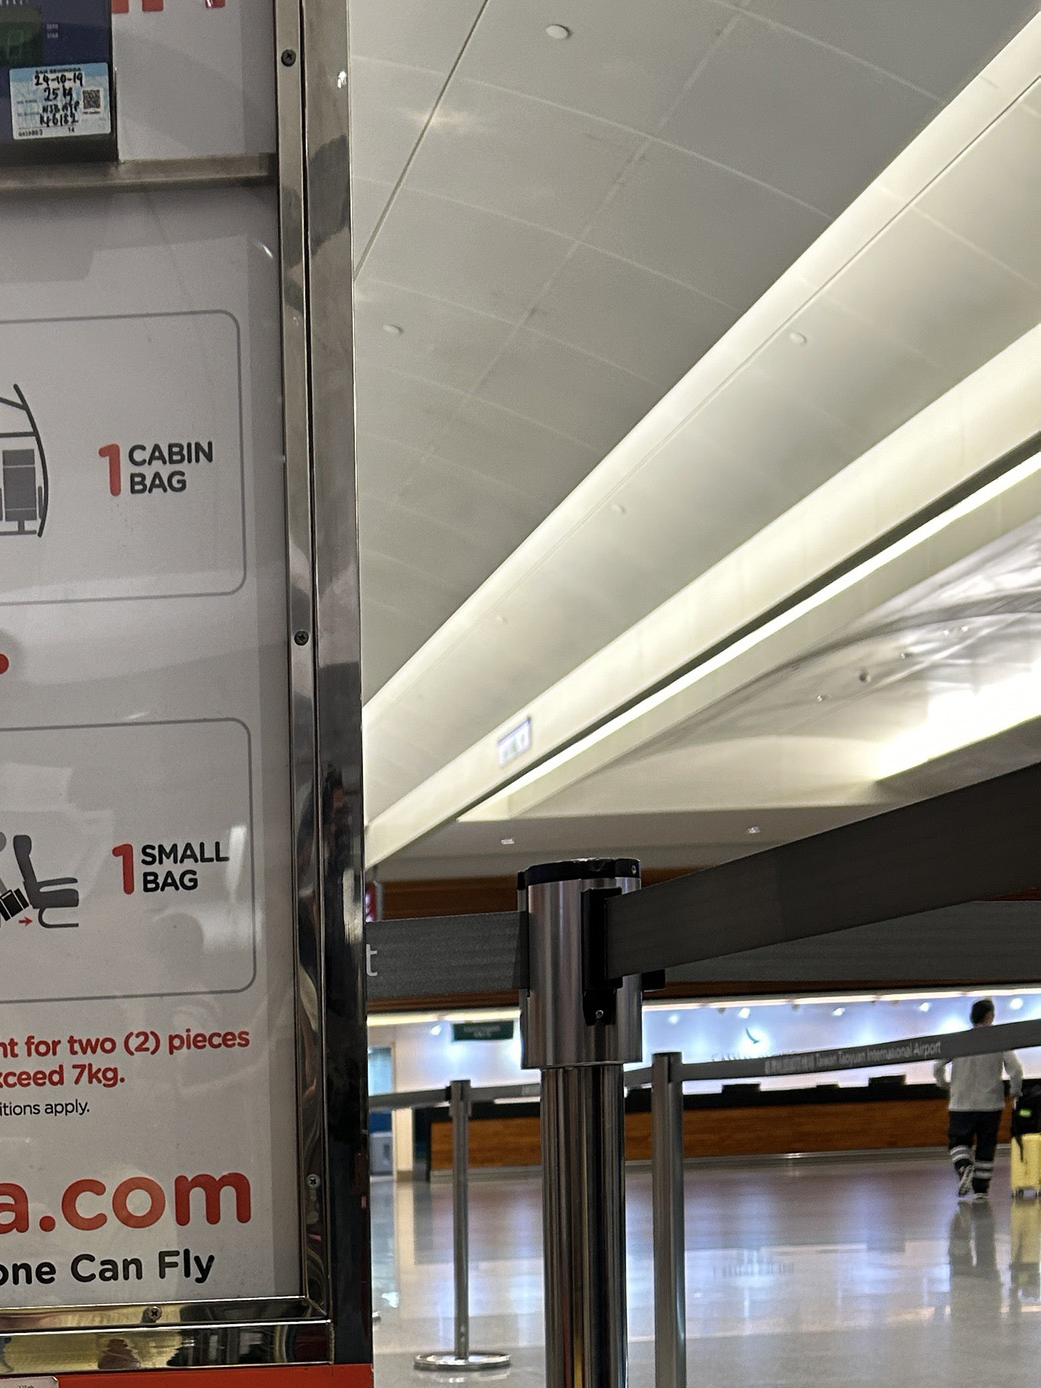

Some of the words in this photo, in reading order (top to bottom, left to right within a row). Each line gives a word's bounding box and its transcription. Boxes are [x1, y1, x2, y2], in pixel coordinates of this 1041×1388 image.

[97, 443, 122, 497] 1
[128, 440, 214, 467] CABIN
[129, 470, 187, 495] BAG
[111, 843, 135, 896] 1
[140, 840, 230, 866] SMALL
[142, 869, 199, 893] BAG
[24, 1035, 62, 1058] for
[66, 1034, 117, 1056] two
[123, 1030, 161, 1057] (2)
[168, 1027, 250, 1056] pieces
[914, 1040, 942, 1060] Airport
[71, 1062, 126, 1089] 7kg.
[44, 1098, 90, 1117] apply.
[70, 1253, 143, 1283] Can
[158, 1248, 216, 1284] Fly
